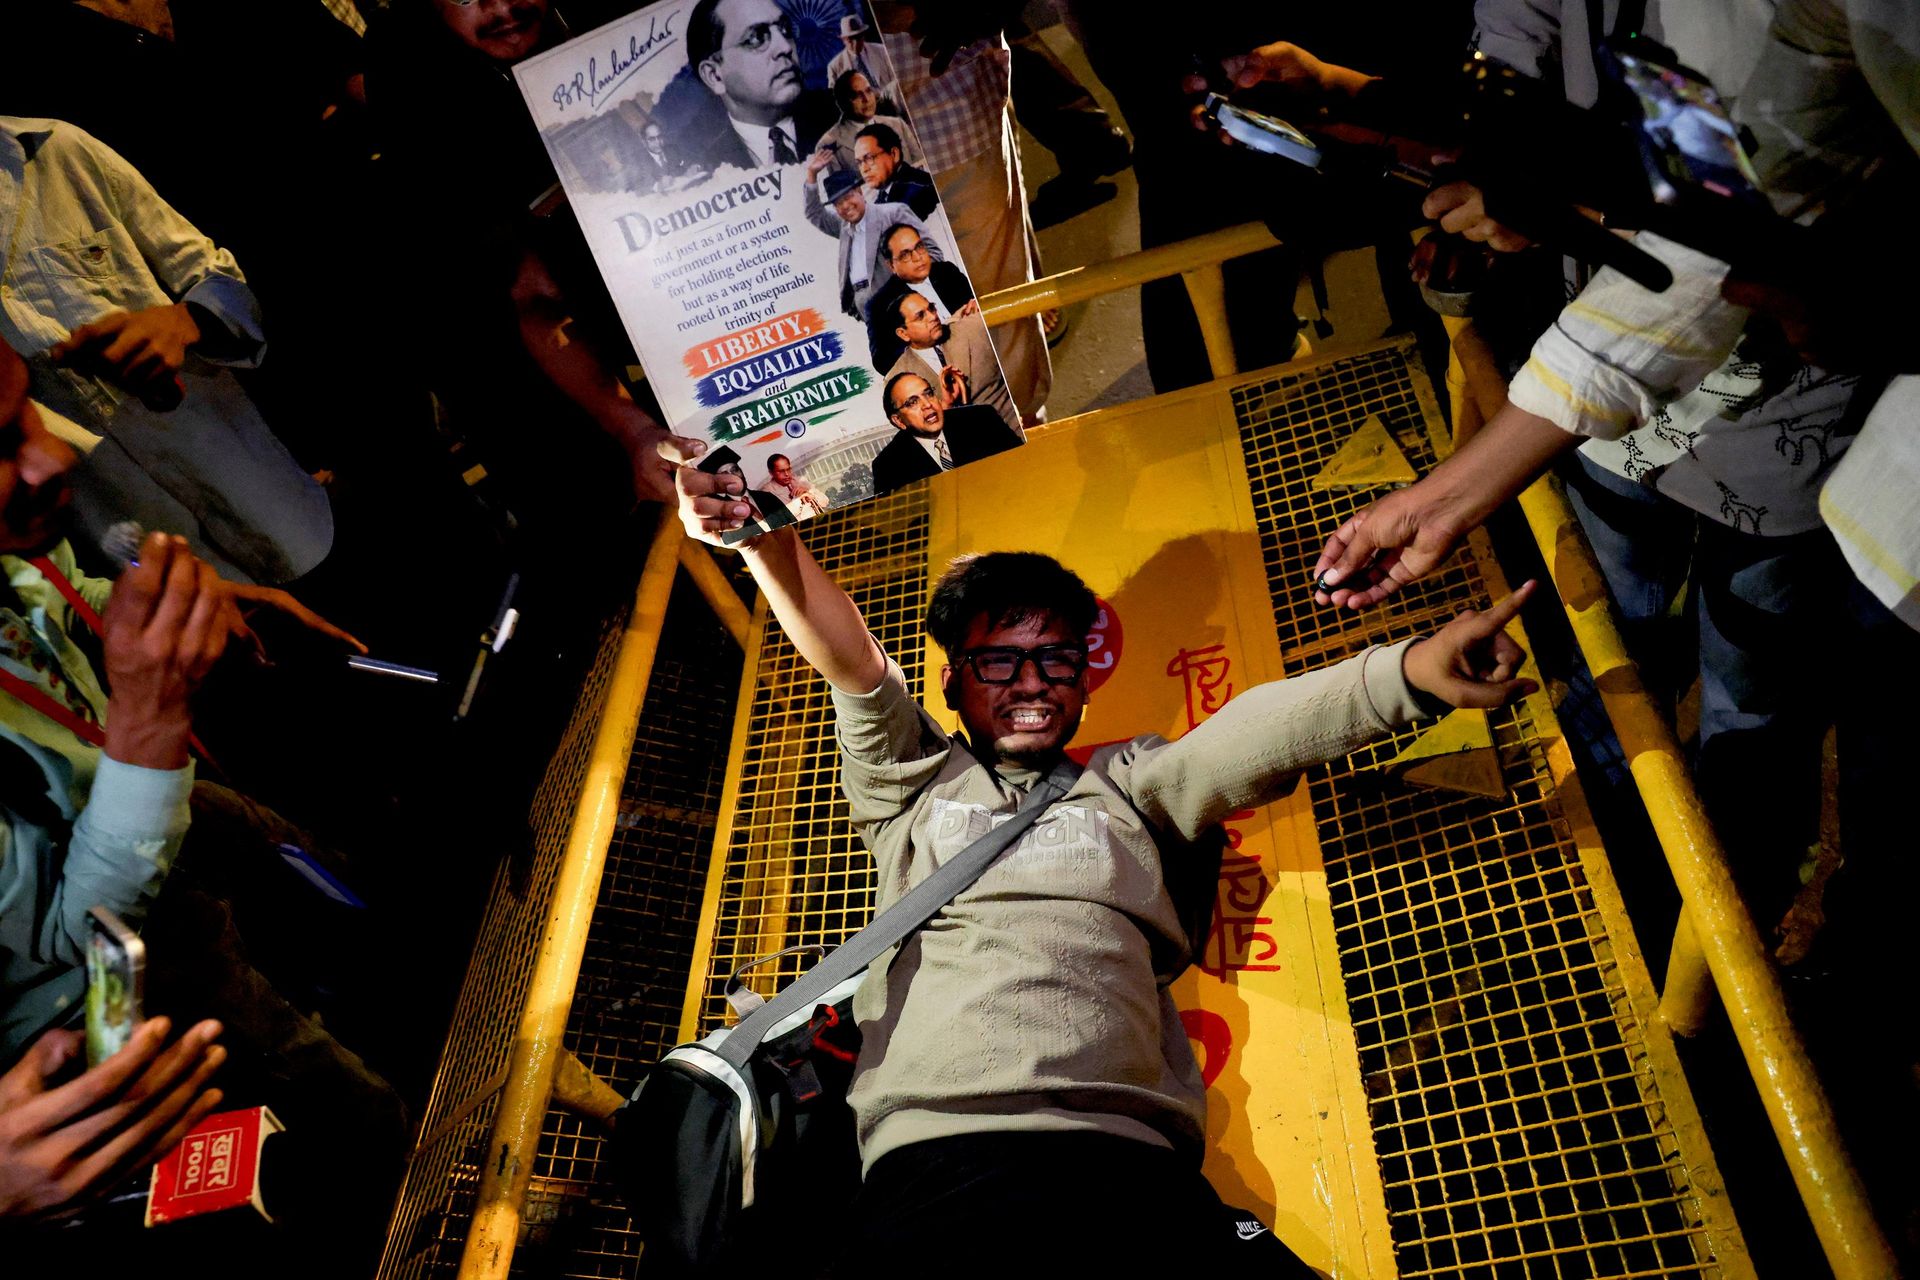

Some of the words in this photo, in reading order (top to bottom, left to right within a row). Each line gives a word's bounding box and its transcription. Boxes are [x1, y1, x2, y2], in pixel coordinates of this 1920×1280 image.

[613, 169, 783, 254] Democracy
[653, 251, 673, 267] not
[676, 240, 699, 261] just
[701, 236, 715, 248] as
[717, 232, 724, 242] a
[725, 219, 757, 238] form
[759, 208, 772, 225] of
[652, 250, 723, 288] government
[725, 244, 737, 256] or
[741, 241, 748, 251] a
[750, 225, 790, 248] system
[668, 285, 686, 298] for
[687, 267, 735, 291] holding
[736, 245, 792, 272] elections,
[677, 308, 715, 332] rooted
[716, 305, 730, 317] in
[732, 298, 748, 311] an
[749, 273, 815, 304] inseparable
[682, 296, 703, 312] but
[705, 291, 719, 303] as
[721, 288, 728, 298] a
[729, 278, 752, 293] way
[755, 268, 768, 284] of
[769, 263, 791, 279] life
[701, 314, 811, 368] LIBERTY,
[725, 309, 762, 331] trinity
[764, 301, 776, 316] of
[713, 338, 832, 396] EQUALITY,
[765, 379, 788, 397] and
[726, 372, 860, 434] FRATERNITY.
[184, 1140, 204, 1190] POOL
[1236, 1221, 1260, 1233] NIKE
